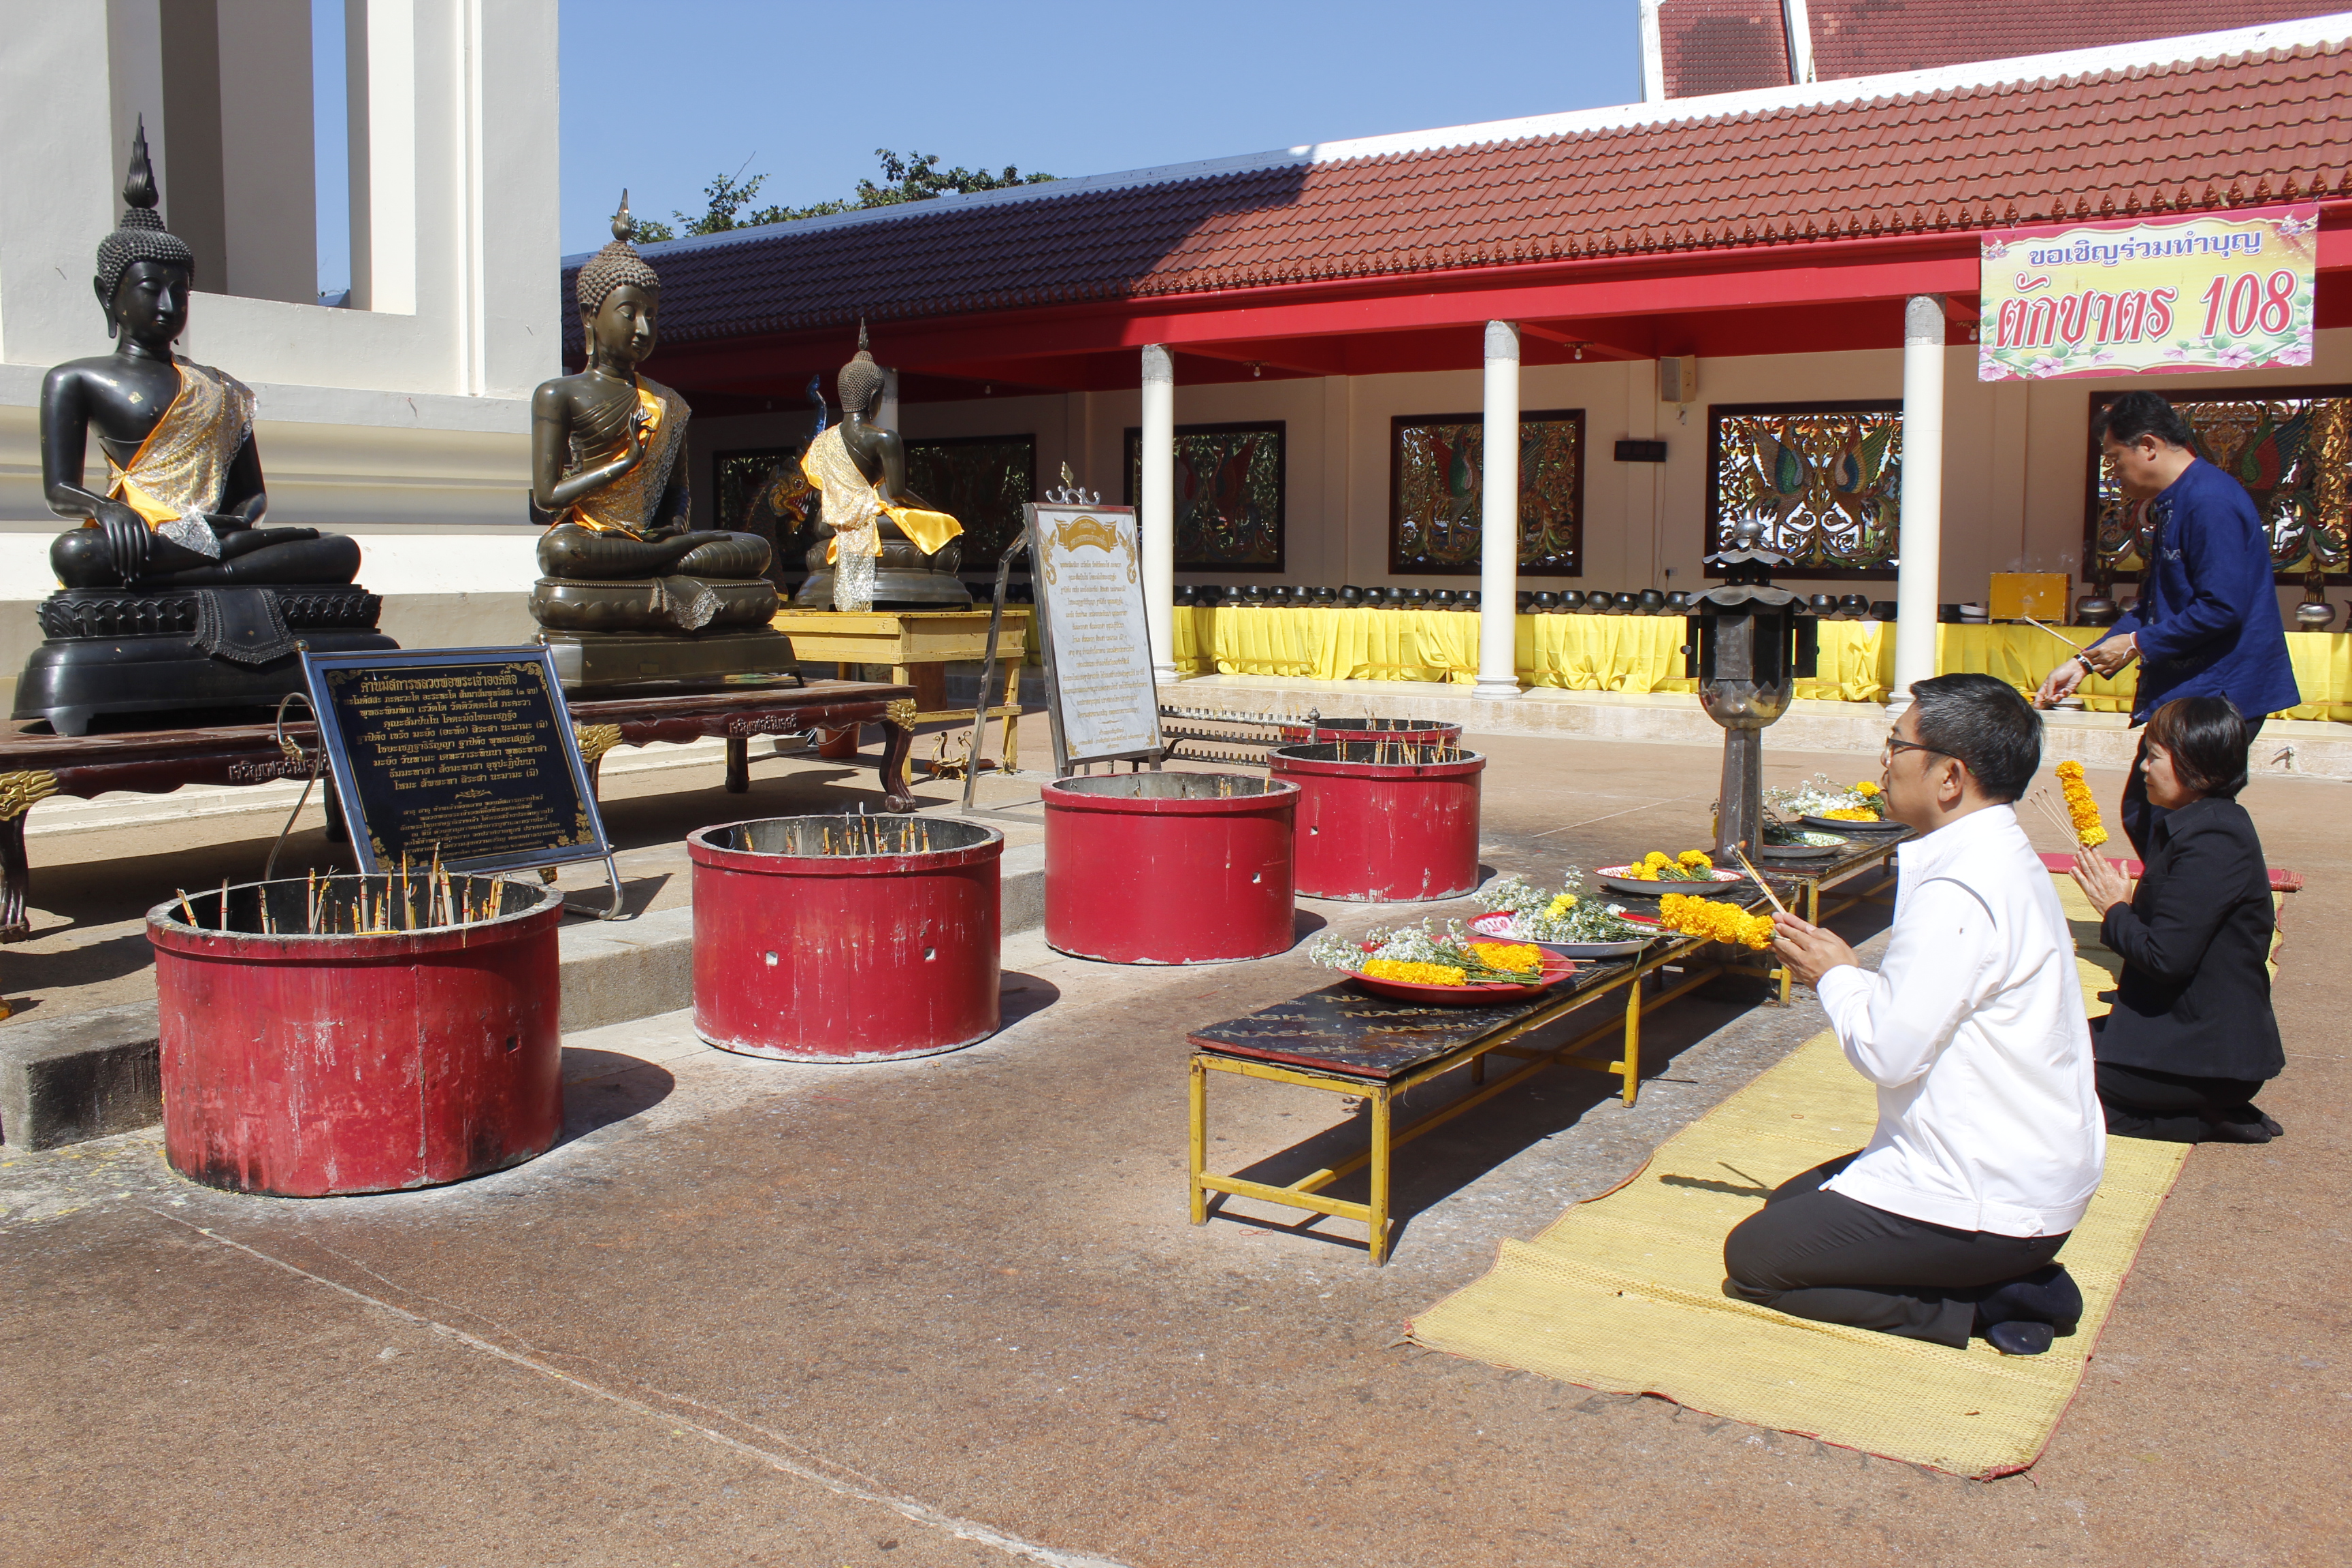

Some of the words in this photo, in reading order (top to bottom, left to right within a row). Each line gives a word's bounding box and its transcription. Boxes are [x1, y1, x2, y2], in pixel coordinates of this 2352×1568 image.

[2029, 229, 2262, 267] ขอเชิญร่วมทำบุญ
[1993, 270, 2178, 349] ตักบาตร
[2200, 267, 2298, 339] 108
[412, 728, 435, 738] มะยัง
[373, 755, 397, 766] มะยัง
[1335, 1008, 1443, 1018] NASH
[1356, 1022, 1467, 1033] NASH
[1211, 1029, 1326, 1038] NASH
